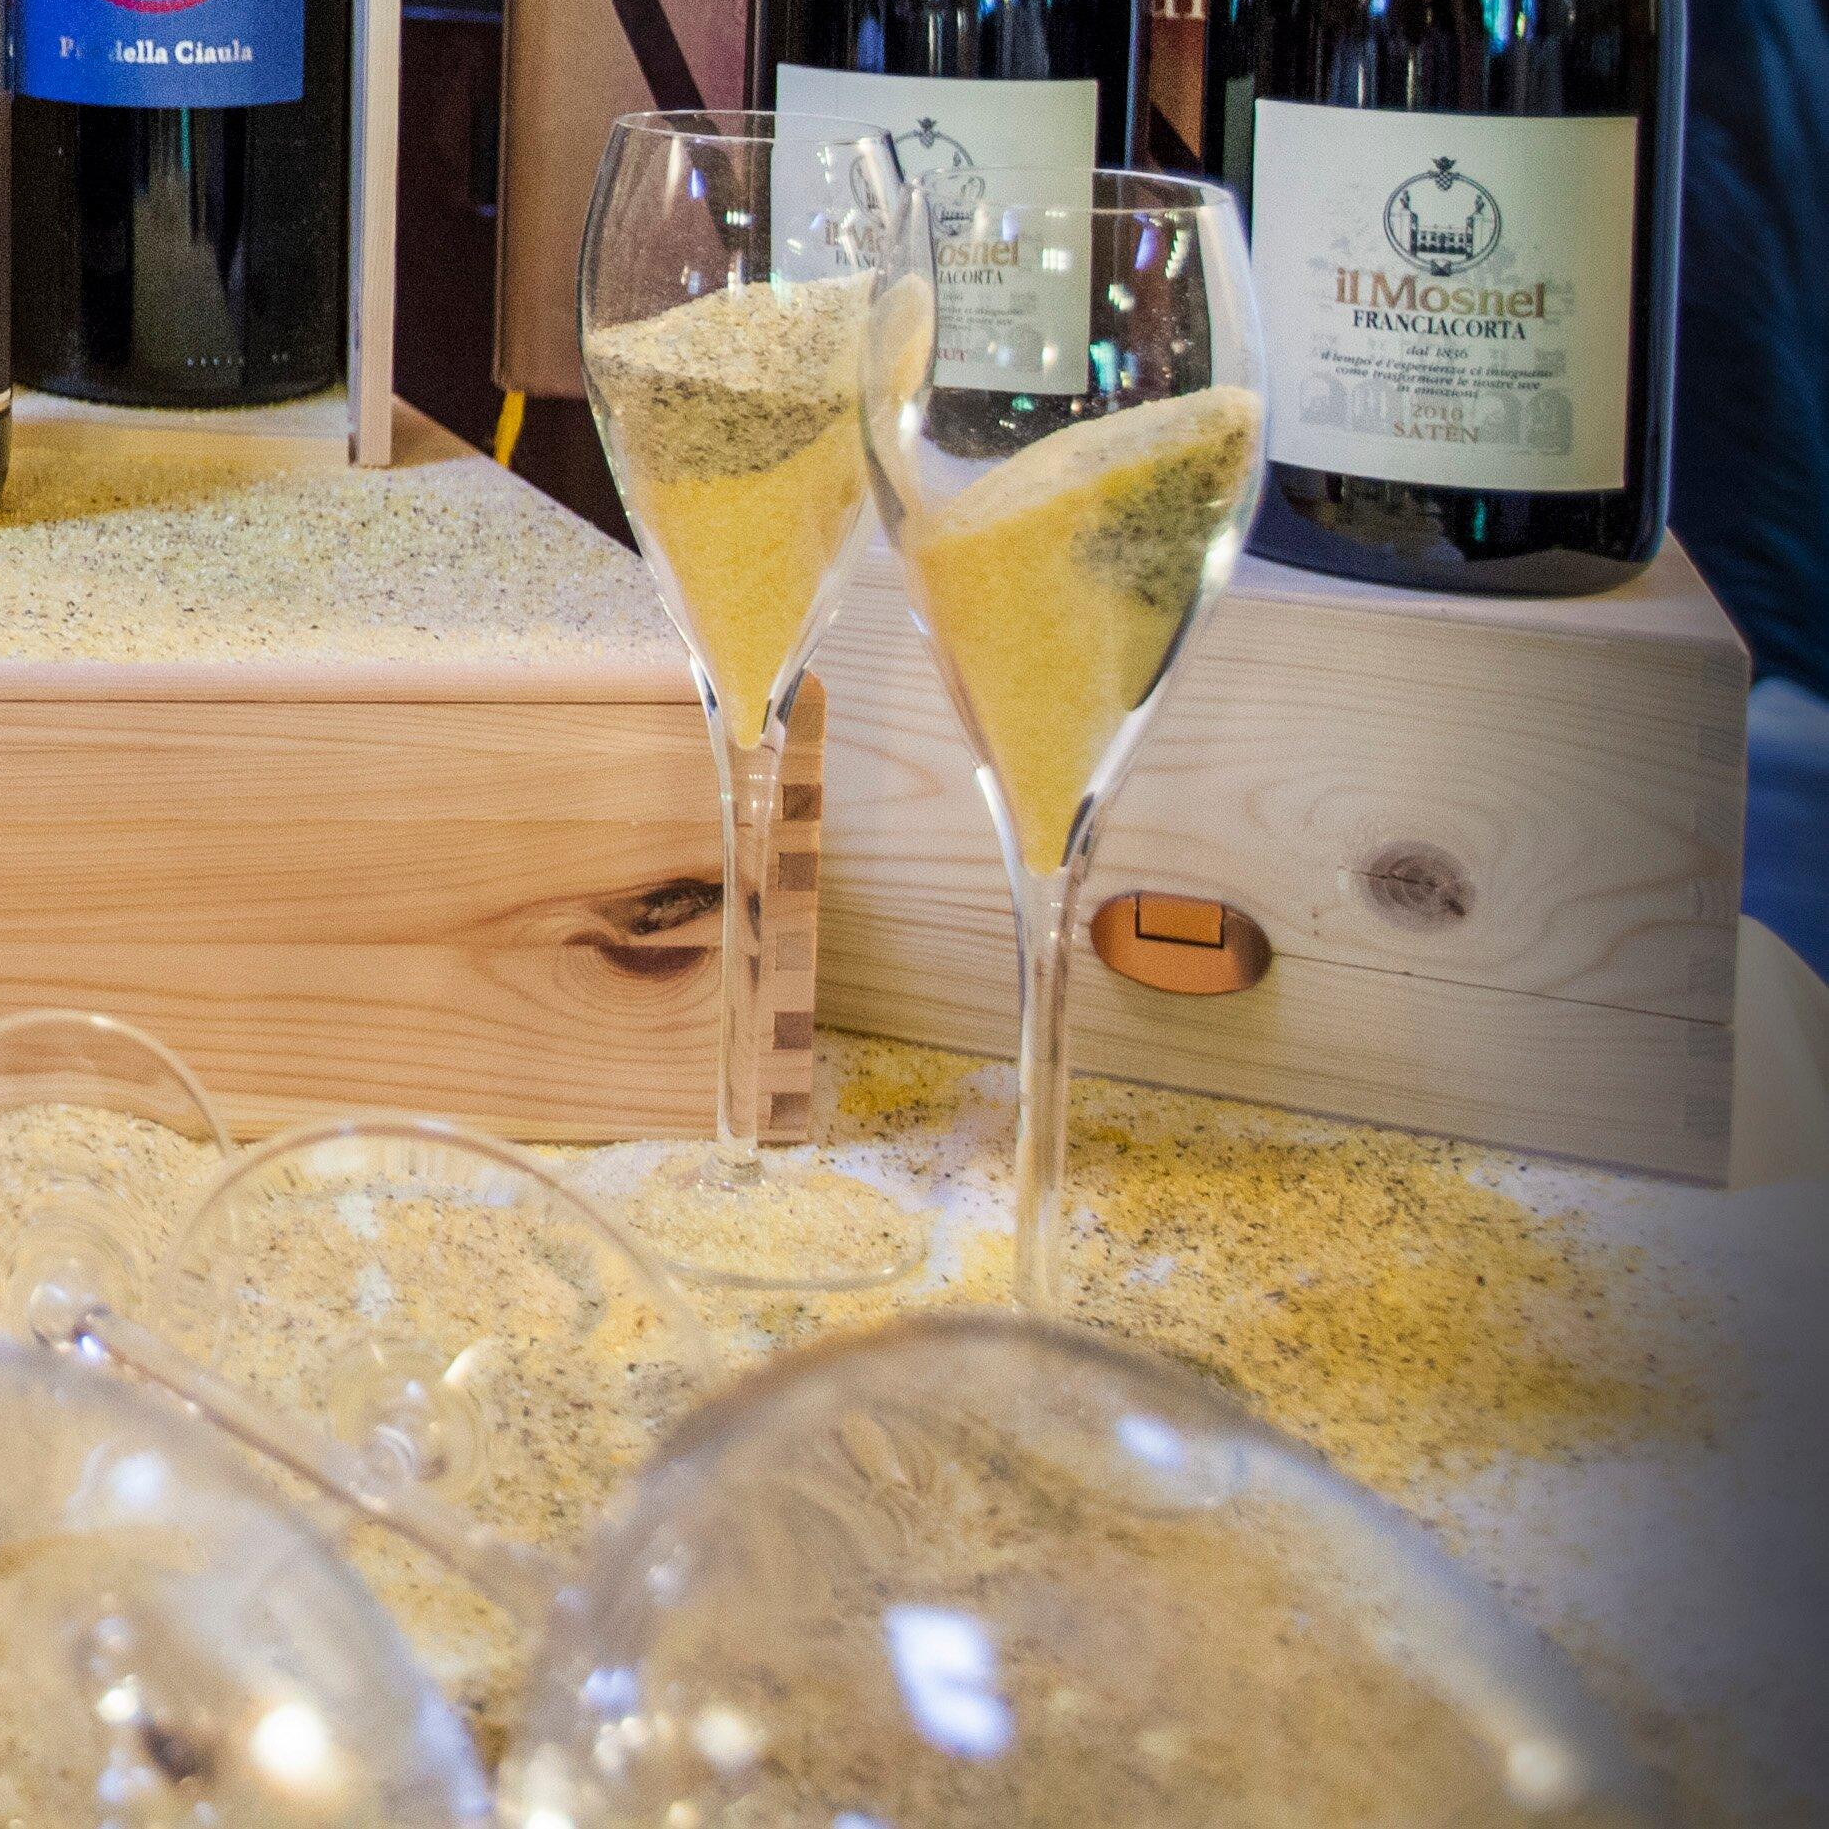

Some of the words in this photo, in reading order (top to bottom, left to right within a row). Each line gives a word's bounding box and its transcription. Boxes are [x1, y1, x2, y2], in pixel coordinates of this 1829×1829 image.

[1335, 267, 1359, 306] il
[1371, 271, 1544, 319] Mosnel
[1353, 308, 1526, 341] FRANCIACORTA
